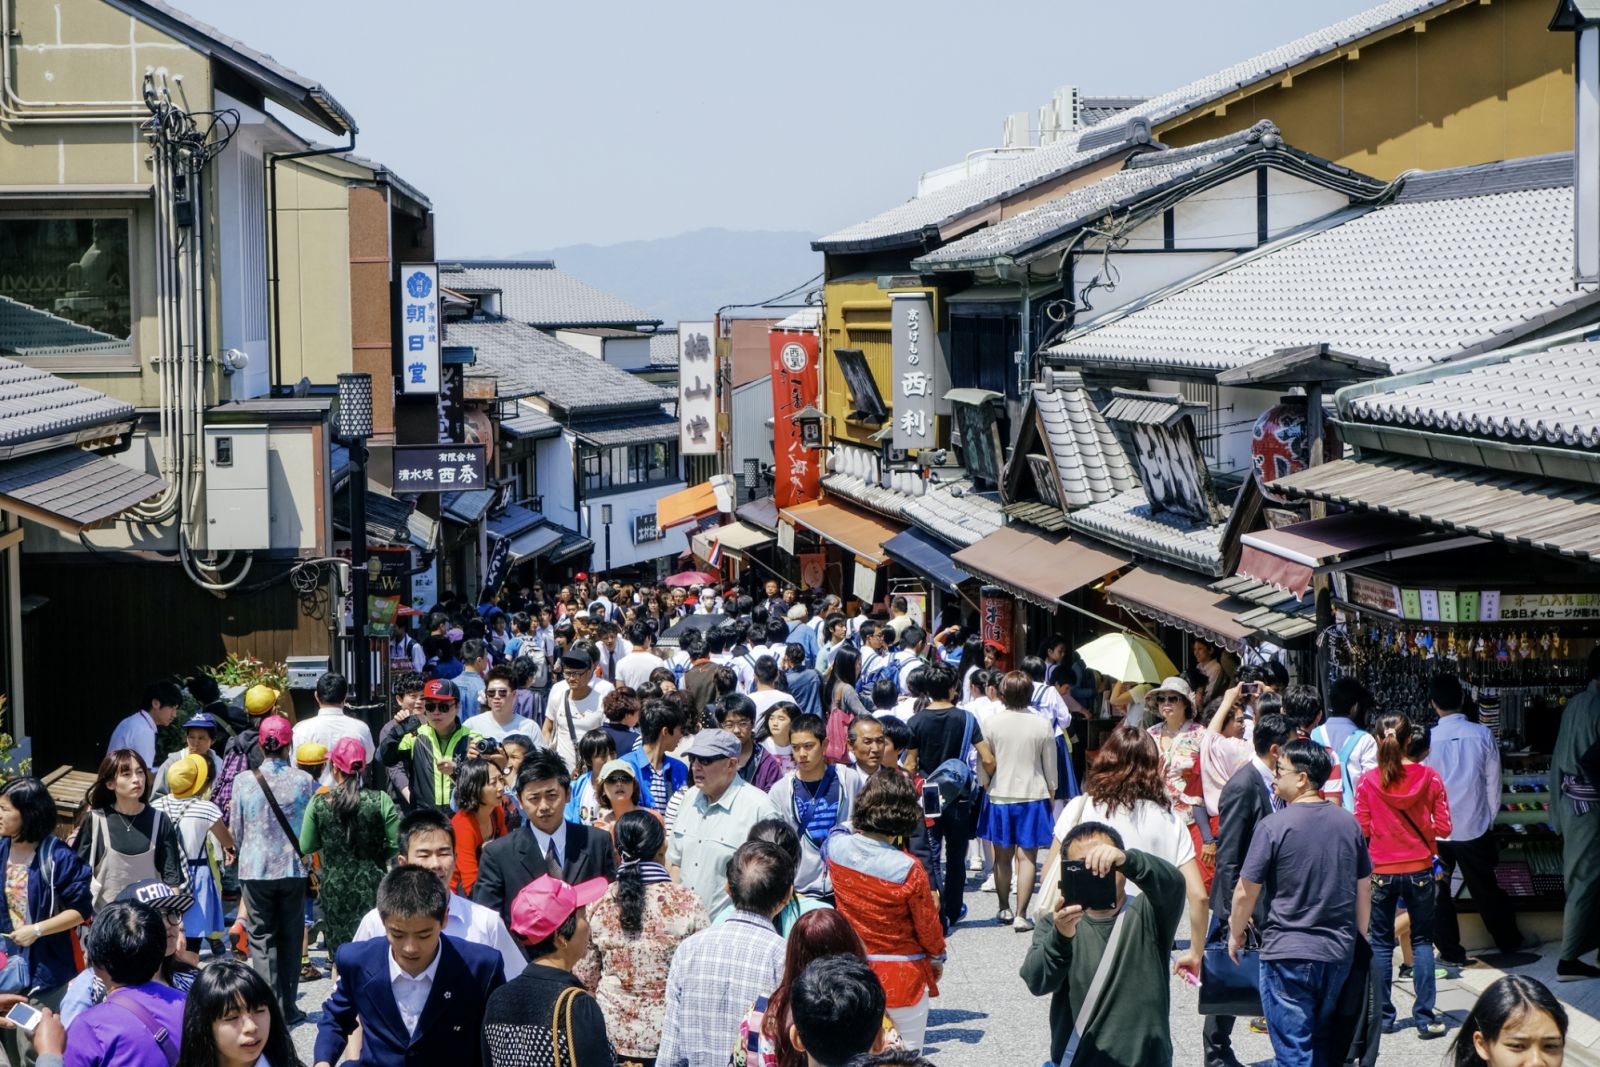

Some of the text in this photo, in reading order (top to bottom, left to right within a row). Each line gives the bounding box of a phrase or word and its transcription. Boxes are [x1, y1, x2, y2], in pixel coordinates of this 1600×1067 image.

[406, 303, 427, 384] 朝日堂
[907, 308, 920, 366] 京つけもの
[900, 371, 928, 437] 西利
[438, 464, 479, 484] 西秀
[439, 452, 477, 462] 有限会社
